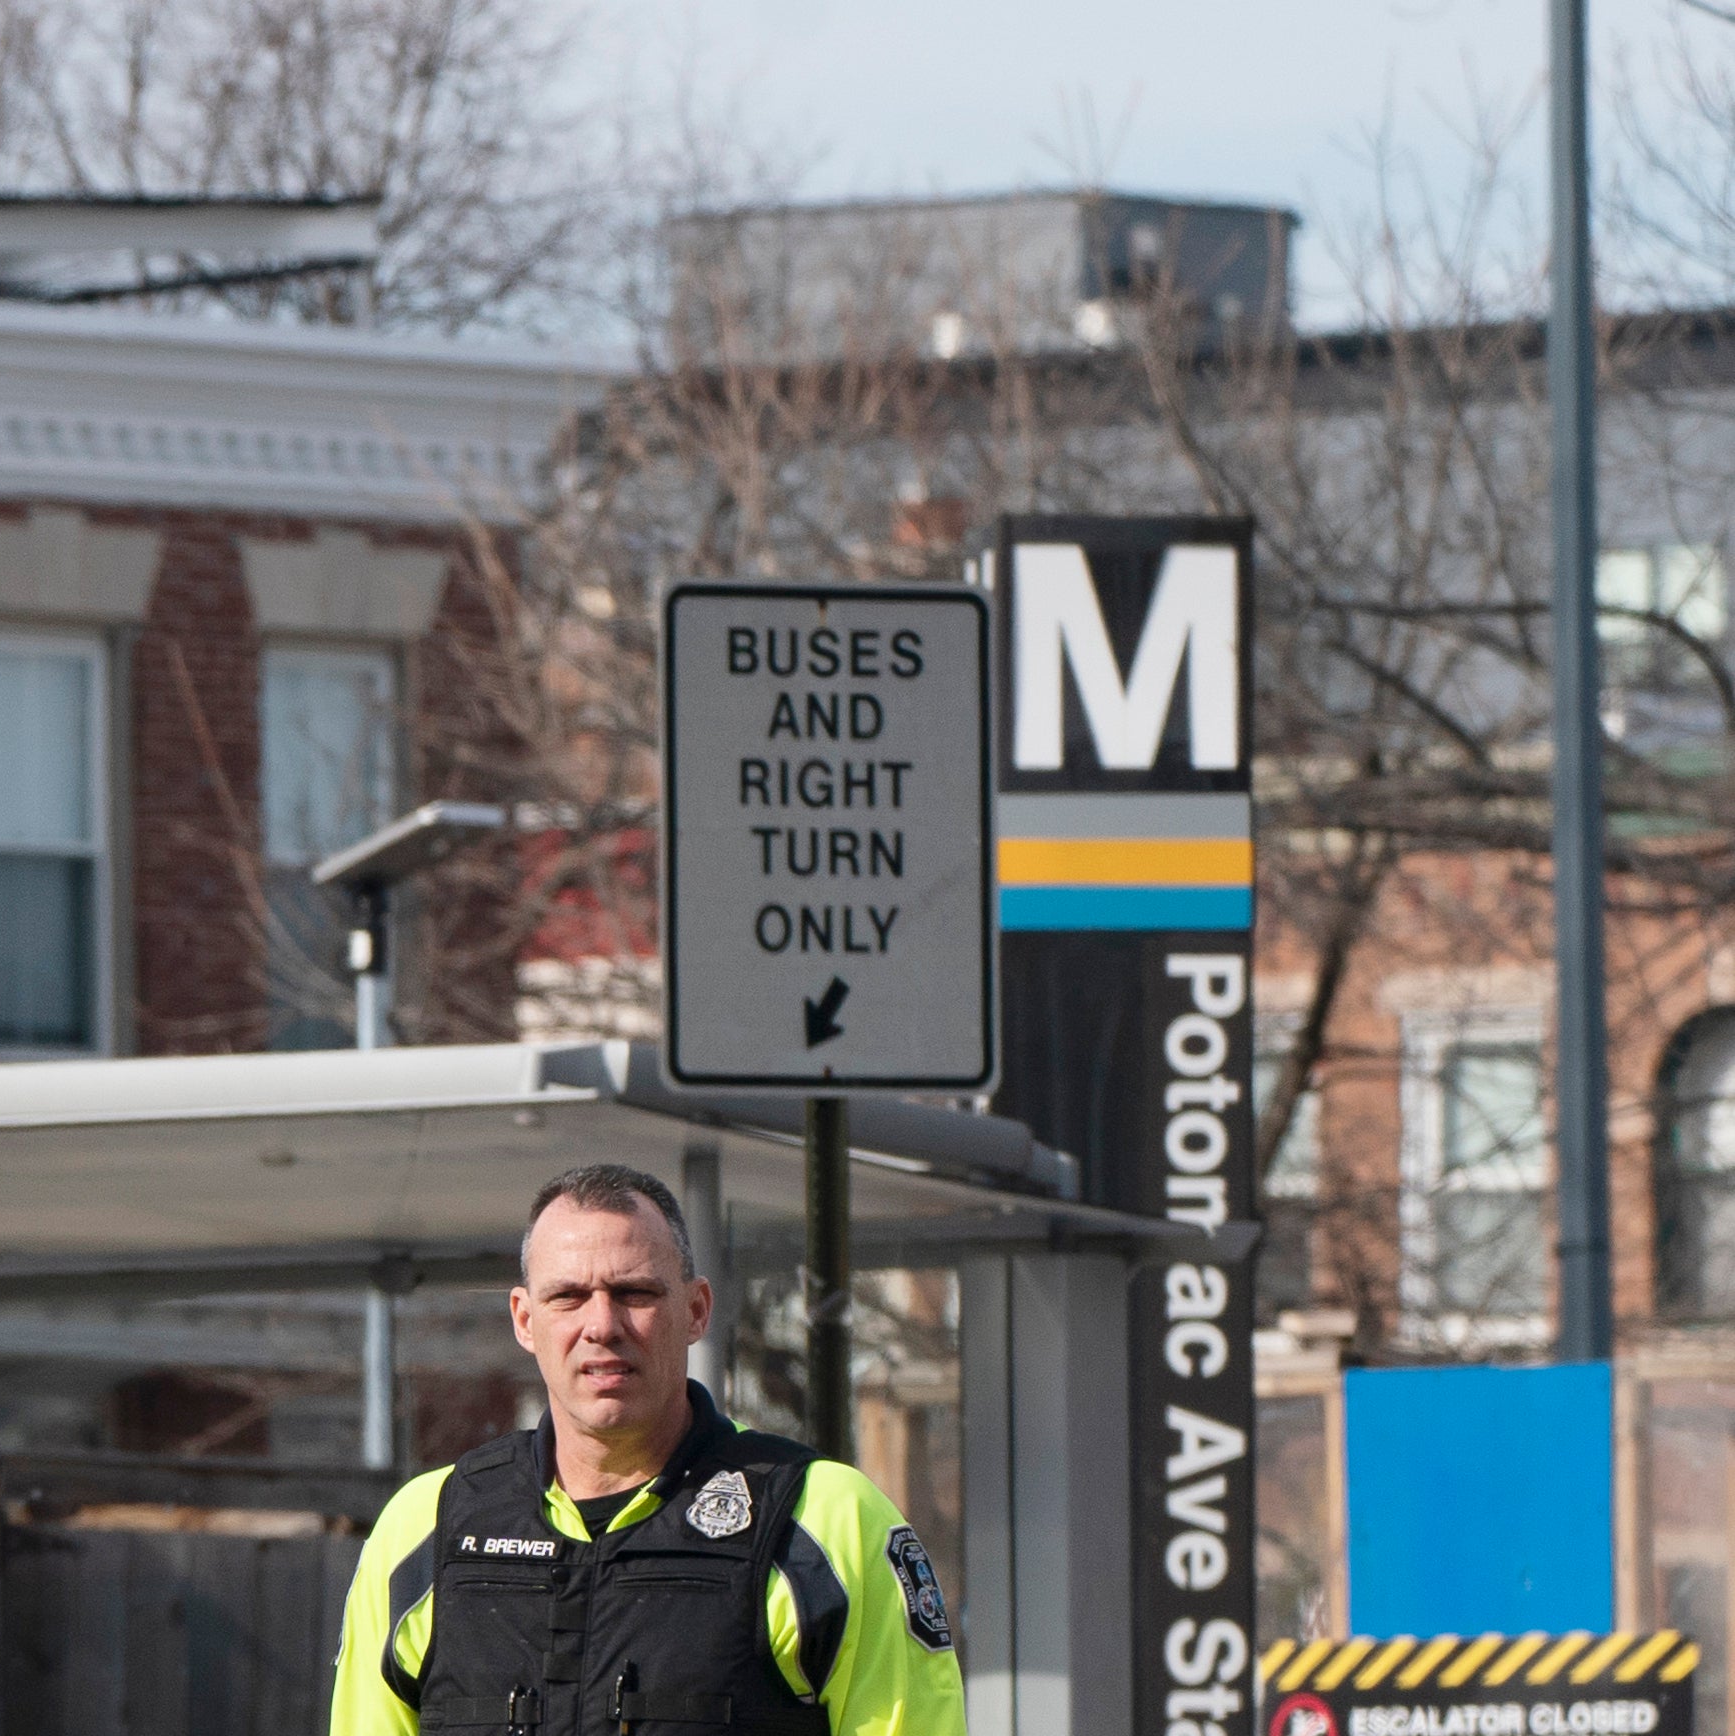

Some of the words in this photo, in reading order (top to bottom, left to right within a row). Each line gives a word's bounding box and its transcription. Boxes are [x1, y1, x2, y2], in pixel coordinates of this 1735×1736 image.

[729, 627, 924, 678] BUSES
[1013, 543, 1238, 770] M
[768, 692, 884, 741] AND
[740, 759, 913, 809] RIGHT
[751, 828, 905, 878] TURN
[755, 905, 899, 954] ONLY
[1165, 1405, 1247, 1591] Ave
[461, 1536, 477, 1551] R.
[483, 1538, 555, 1556] BREWER
[1529, 1699, 1659, 1736] CLOSED
